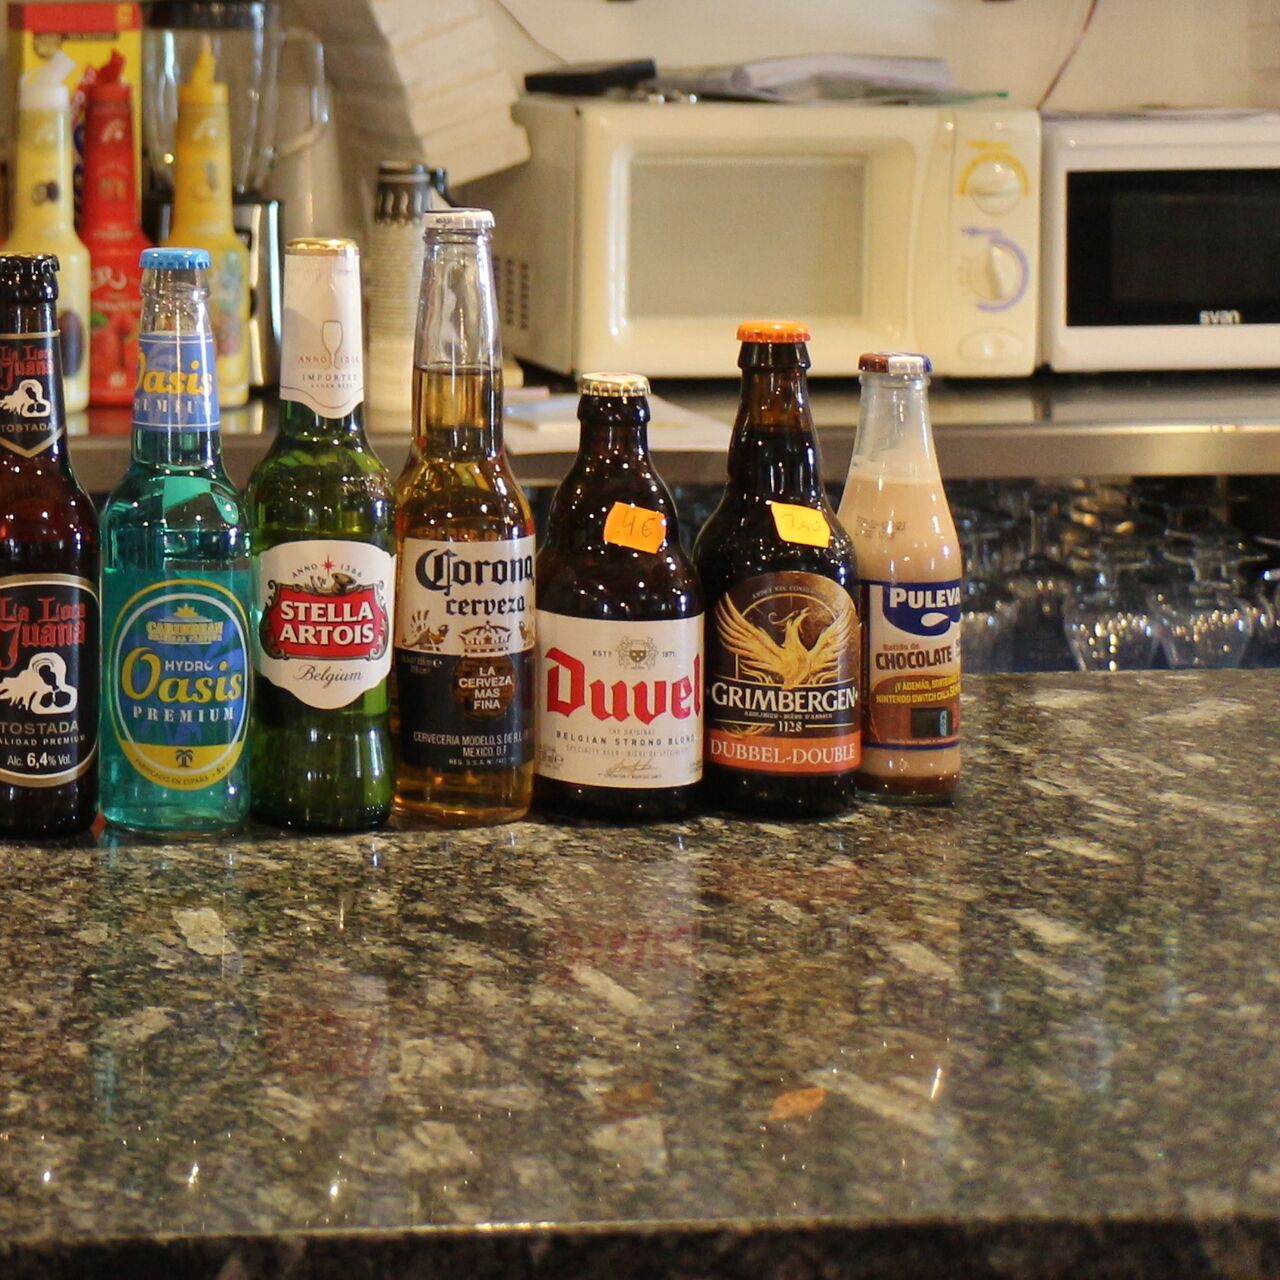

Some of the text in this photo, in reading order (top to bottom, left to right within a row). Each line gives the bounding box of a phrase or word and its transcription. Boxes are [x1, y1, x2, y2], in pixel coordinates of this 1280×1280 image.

[299, 355, 327, 364] ANNO
[0, 422, 53, 433] TOSTADA
[292, 564, 363, 578] ANNO 1366
[415, 548, 535, 596] Corona
[446, 595, 525, 616] cerveza
[889, 586, 961, 609] PULEVA
[280, 600, 374, 622] STELLA
[279, 624, 375, 645] ARTOIS
[875, 645, 952, 670] CHOCOLATE
[164, 661, 215, 672] HYDRO
[479, 666, 496, 676] LA
[121, 647, 242, 704] Oasis
[293, 664, 363, 688] Belgium
[458, 675, 513, 688] CERVEZA
[474, 688, 501, 699] MAS
[545, 647, 701, 725] Duvel
[473, 700, 501, 710] FINA
[711, 681, 856, 713] GRIMBERGEN
[876, 693, 911, 704] NINTENDO
[133, 705, 234, 723] PREMIUM
[778, 720, 803, 733] 1128
[42, 735, 86, 746] PREMIUM
[413, 731, 460, 746] CERVECERIA
[556, 729, 695, 747] BELGIAN STRONG BLOND
